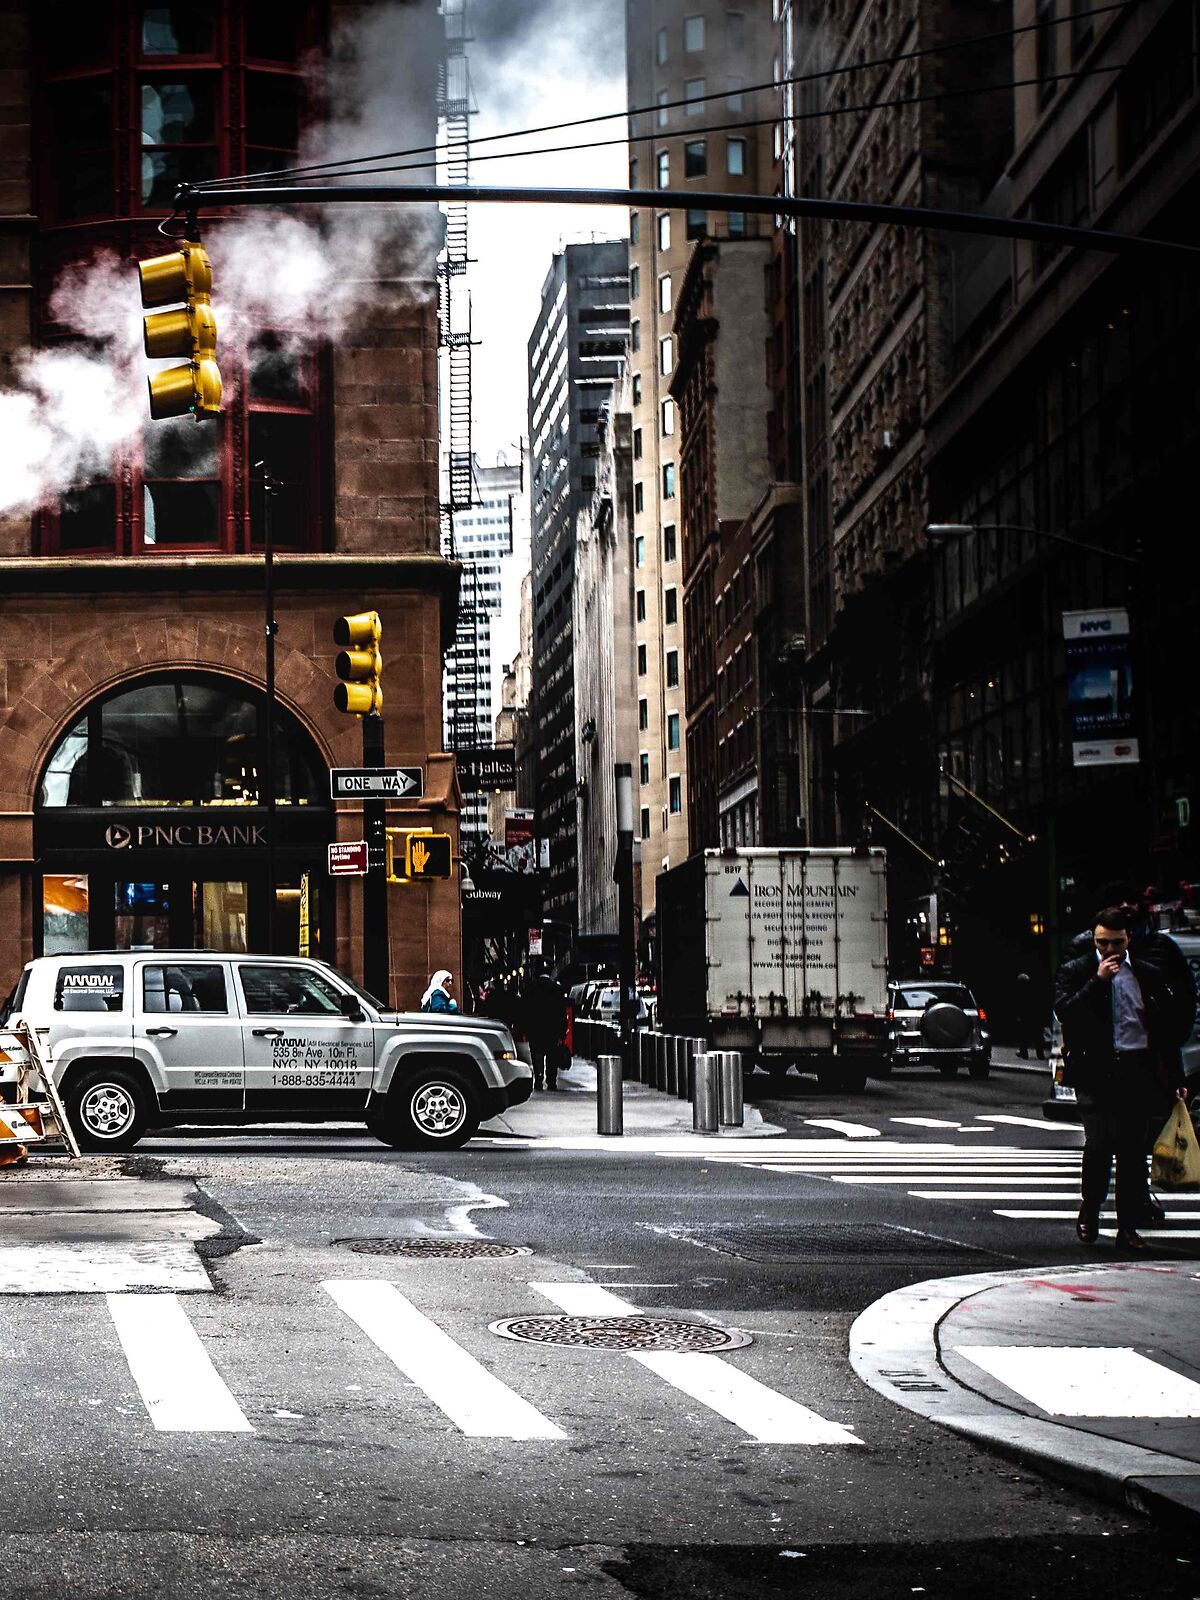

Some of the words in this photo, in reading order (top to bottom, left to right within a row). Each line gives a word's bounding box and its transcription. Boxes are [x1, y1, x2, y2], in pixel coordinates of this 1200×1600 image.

[1080, 620, 1111, 633] NYC
[345, 778, 371, 790] ONE
[381, 777, 408, 789] WAY
[137, 825, 193, 846] PNC
[198, 825, 267, 845] BANK
[465, 888, 502, 901] Subway
[754, 885, 783, 897] IRON
[787, 884, 856, 898] MOUNTAIN
[273, 1048, 289, 1058] 535
[292, 1048, 304, 1057] 8th
[305, 1048, 325, 1058] Ave.
[329, 1048, 345, 1057] 10th
[304, 1060, 321, 1069] NY
[325, 1060, 357, 1070] 10018
[272, 1075, 356, 1086] 1-888-835-4444
